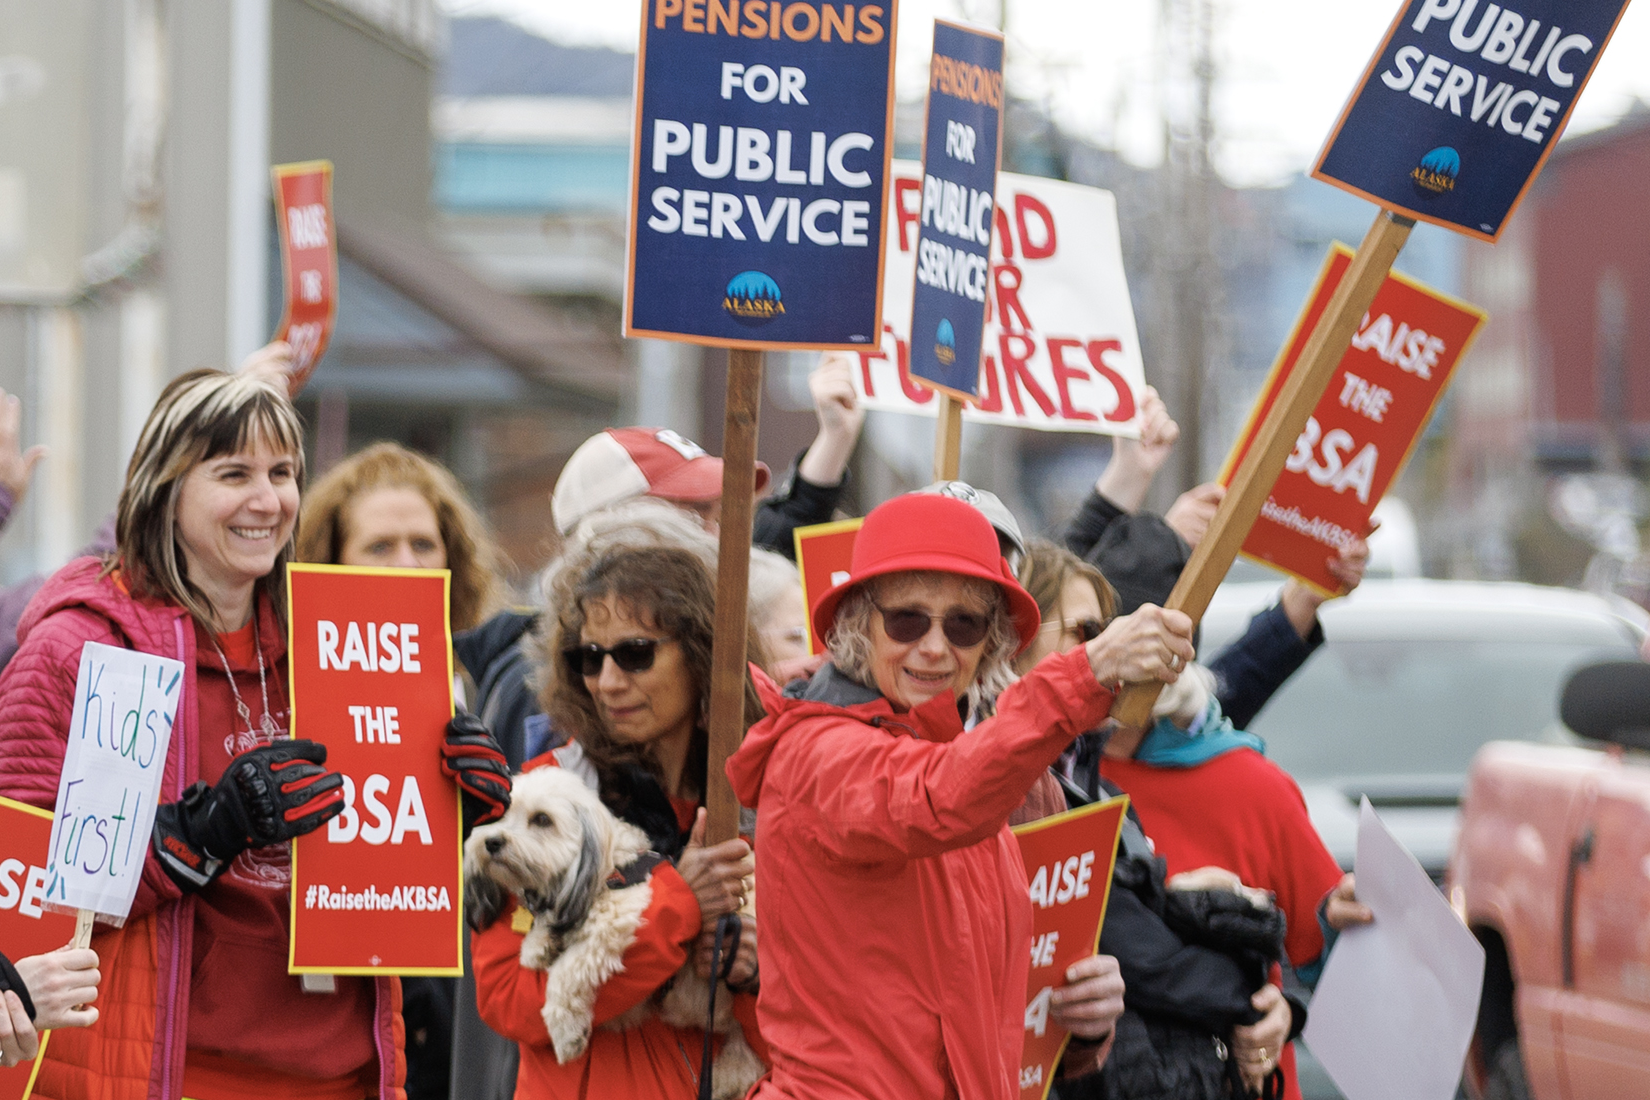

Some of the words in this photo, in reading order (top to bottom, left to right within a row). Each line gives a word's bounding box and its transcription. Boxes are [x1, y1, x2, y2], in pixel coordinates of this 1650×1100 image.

[654, 0, 885, 45] PENSIONS
[1411, 0, 1594, 88] PUBLIC
[720, 61, 810, 105] FOR
[931, 53, 1002, 110] PENSIONS
[1380, 45, 1561, 144] SERVICE
[652, 118, 875, 188] PUBLIC
[946, 119, 976, 165] FOR
[646, 186, 871, 247] SERVICE
[895, 178, 1057, 260] FD
[921, 173, 994, 246] PUBLIC
[917, 237, 989, 302] SERVICE
[721, 296, 787, 314] ALASKA
[858, 326, 1136, 423] FUURES
[1339, 371, 1394, 424] THE
[1285, 415, 1379, 505] BSA
[316, 619, 422, 674] RAISE
[348, 705, 402, 744] THE
[53, 779, 142, 878] First!
[327, 773, 434, 846] BSA
[305, 884, 451, 912] #RaisetheAKBSA
